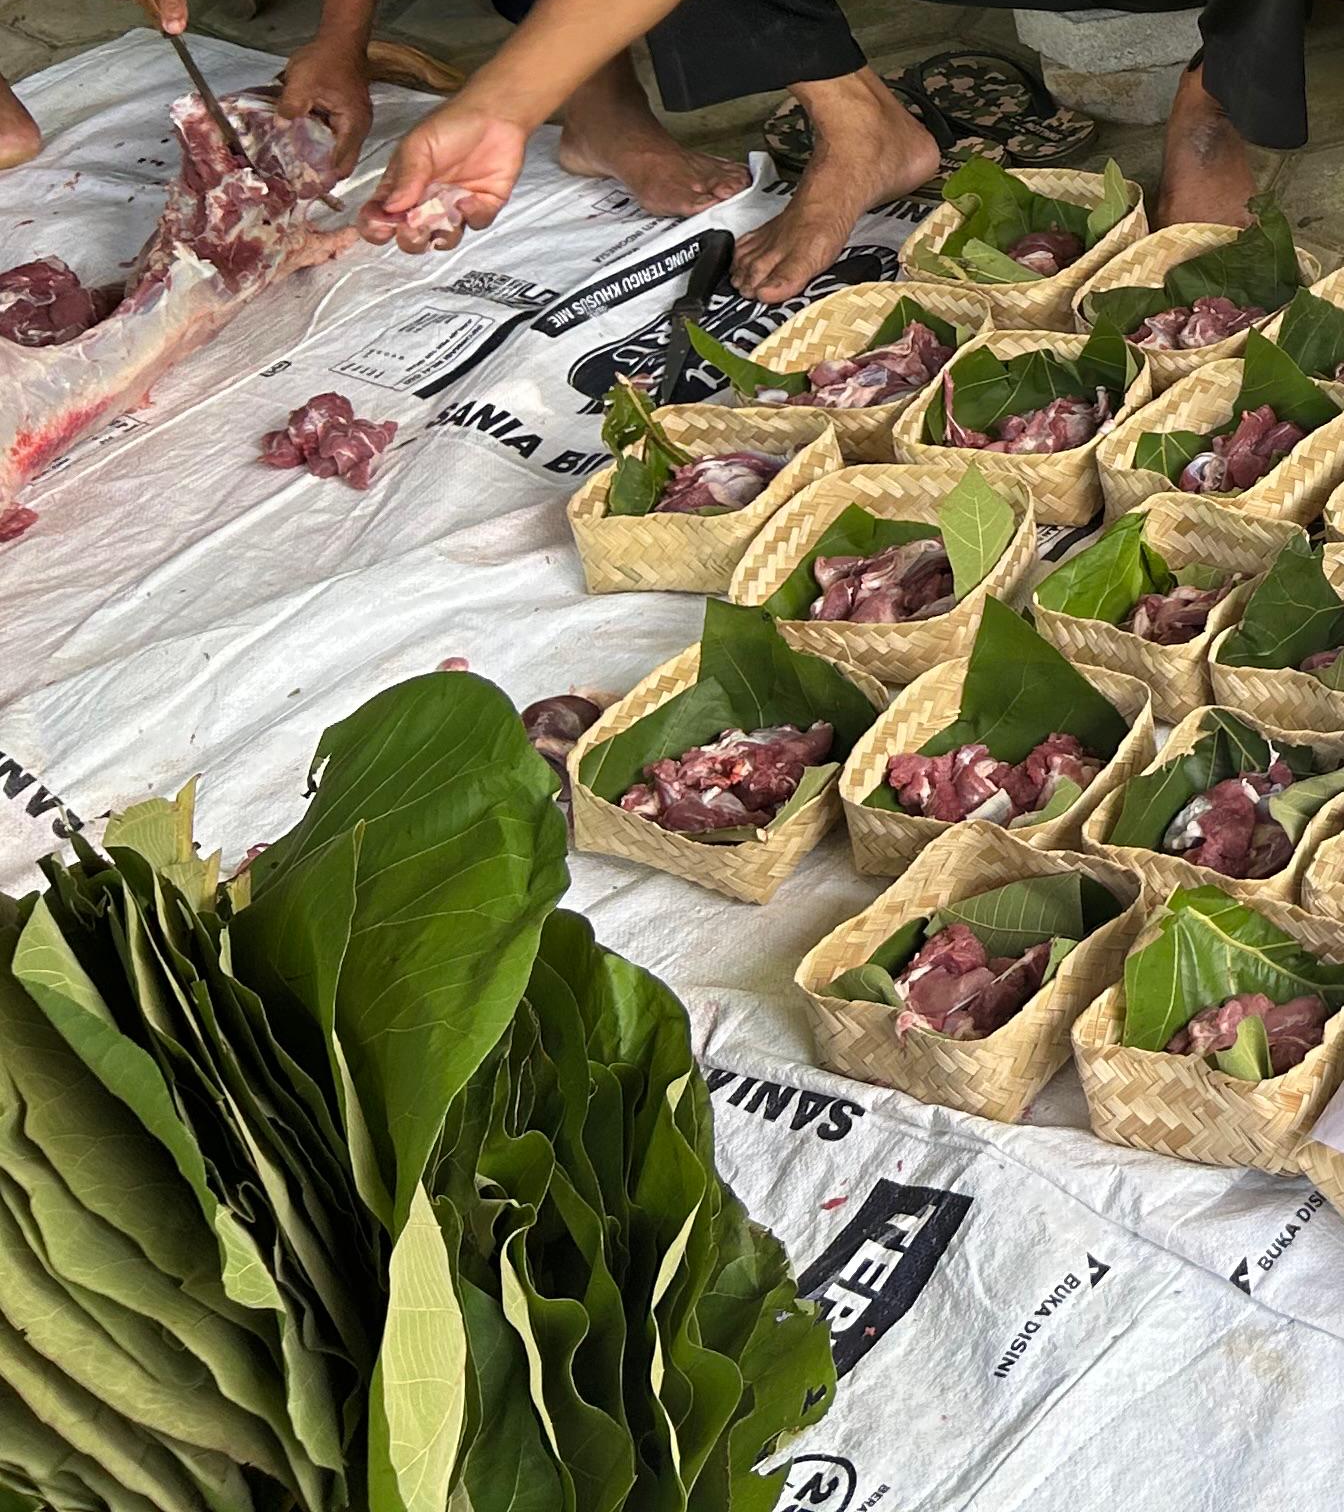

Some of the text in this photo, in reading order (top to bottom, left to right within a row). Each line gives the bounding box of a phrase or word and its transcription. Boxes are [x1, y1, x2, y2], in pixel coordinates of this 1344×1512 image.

[666, 241, 700, 271] EPUNG
[622, 263, 666, 293] TERIGU
[572, 286, 622, 315] KHUSUS
[546, 308, 575, 329] MIE
[425, 400, 544, 460] SANIA
[1257, 1190, 1328, 1271] BUKA DISI
[993, 1273, 1081, 1378] BUKA DISINI
